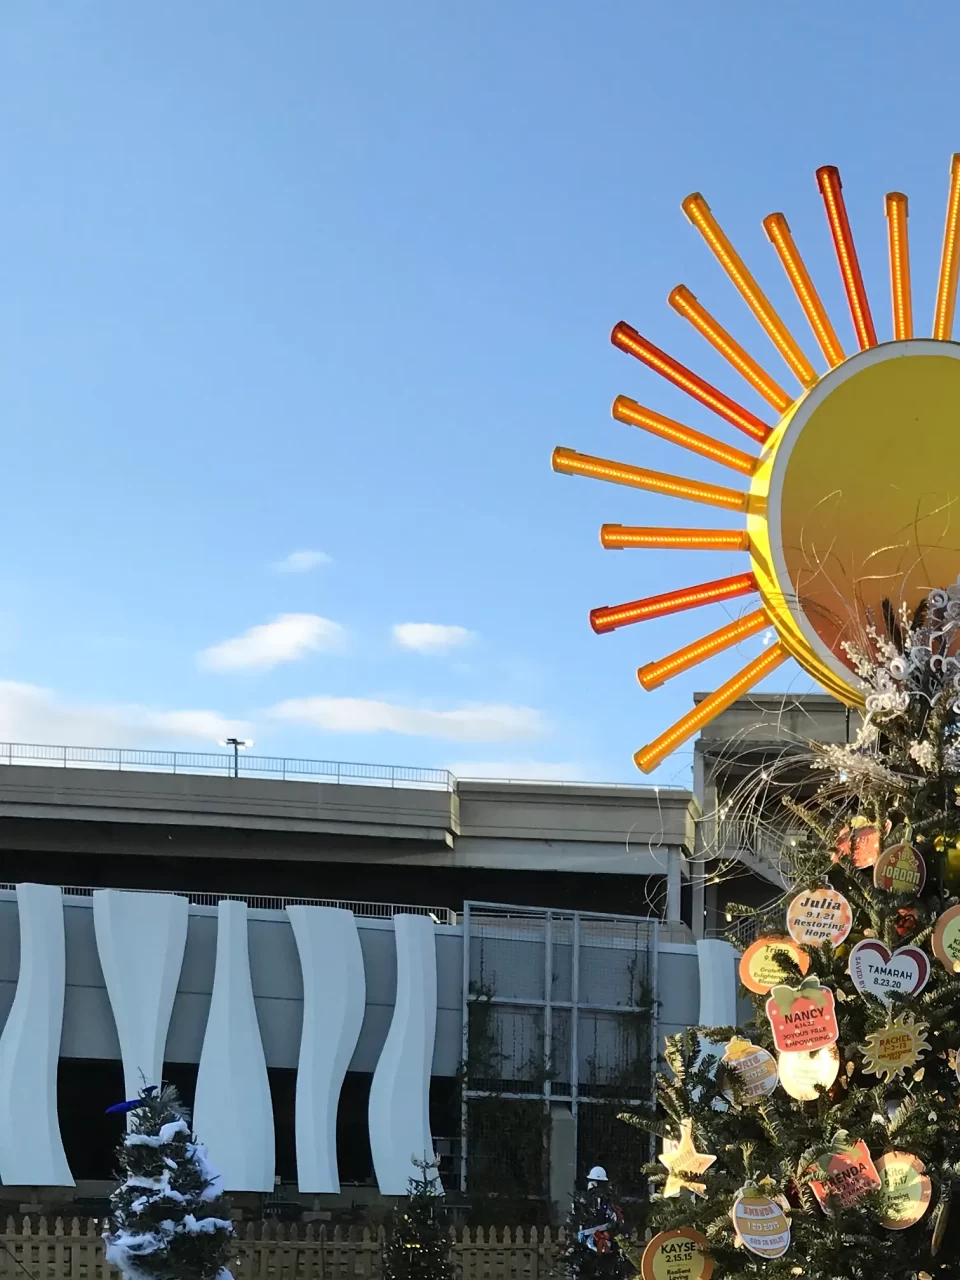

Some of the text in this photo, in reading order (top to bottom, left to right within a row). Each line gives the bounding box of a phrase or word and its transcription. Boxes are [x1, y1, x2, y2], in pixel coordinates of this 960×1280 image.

[881, 865, 920, 884] JORDAN
[800, 898, 841, 910] Julia
[806, 912, 834, 920] 9.1.21
[794, 919, 844, 932] Restoring
[805, 930, 831, 938] Hope
[869, 965, 912, 980] TAMARAH
[874, 978, 901, 988] 8.23.20
[784, 1008, 824, 1024] NANCY
[782, 1030, 808, 1040] JOYOUS
[879, 1034, 912, 1046] RACHEL
[785, 1035, 830, 1048] EMPOWERING
[661, 1242, 696, 1254] KAYSE
[666, 1253, 692, 1262] 2.15.15
